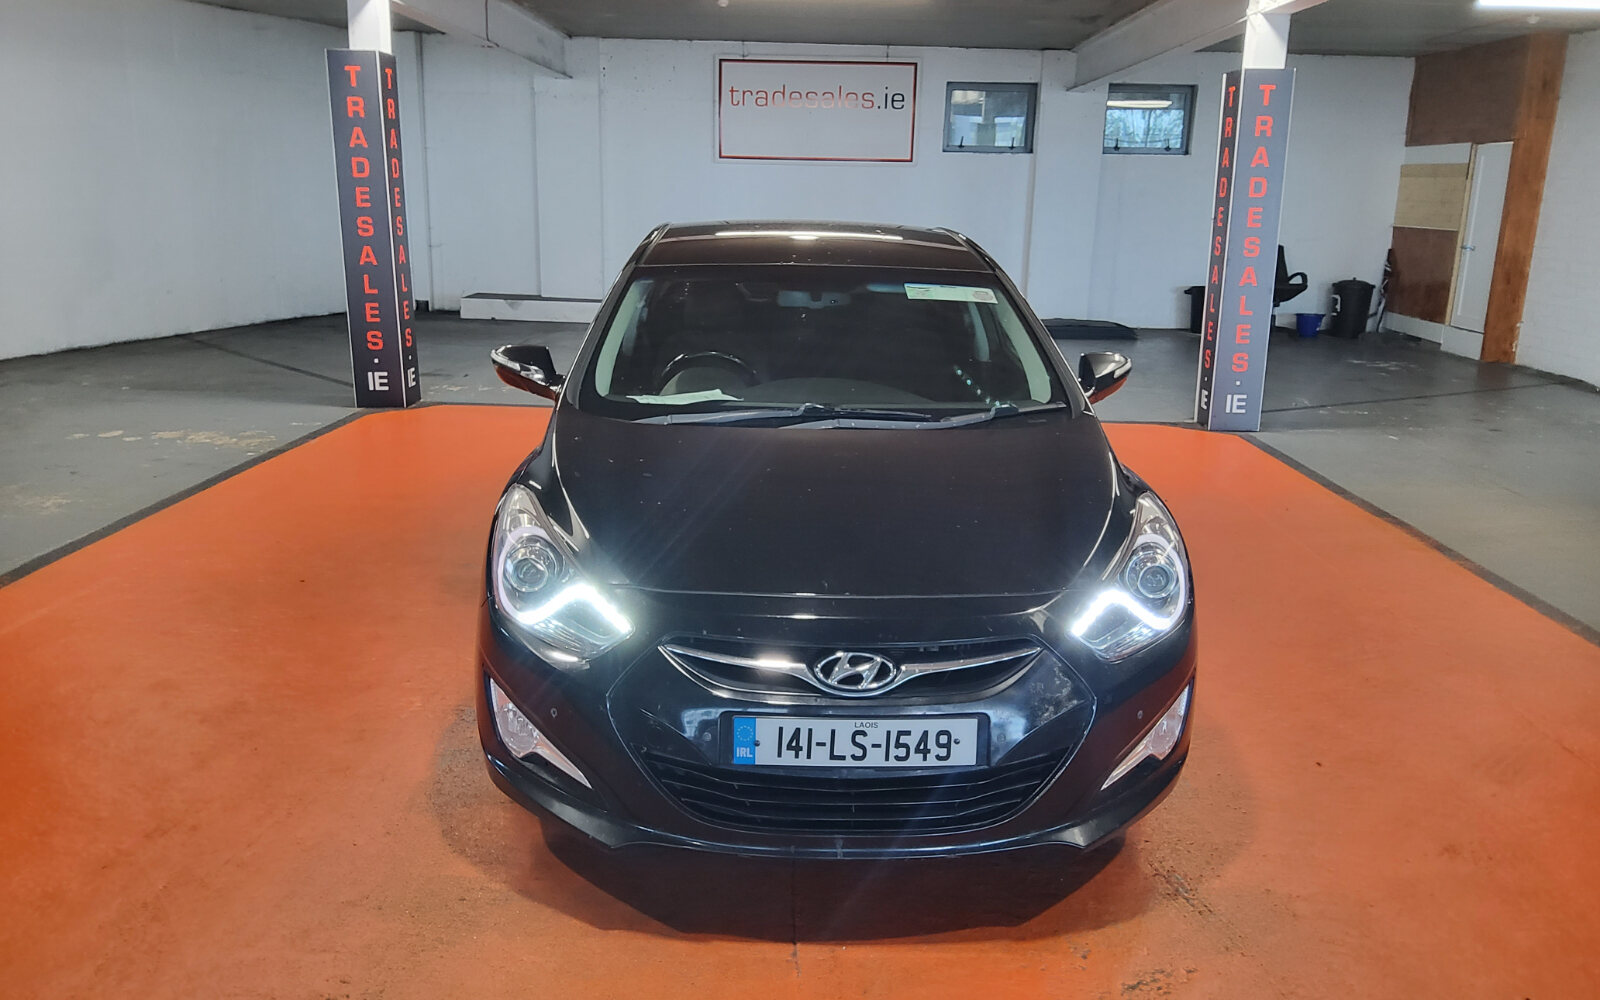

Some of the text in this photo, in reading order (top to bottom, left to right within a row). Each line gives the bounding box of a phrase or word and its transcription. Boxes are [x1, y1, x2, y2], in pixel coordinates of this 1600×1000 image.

[729, 84, 905, 110] tradesales.ie
[344, 64, 389, 391] TRADESALES.IE
[1225, 84, 1276, 414] TRADESALES.IE
[736, 746, 753, 758] IRL
[777, 726, 952, 762] 141-LS-1549
